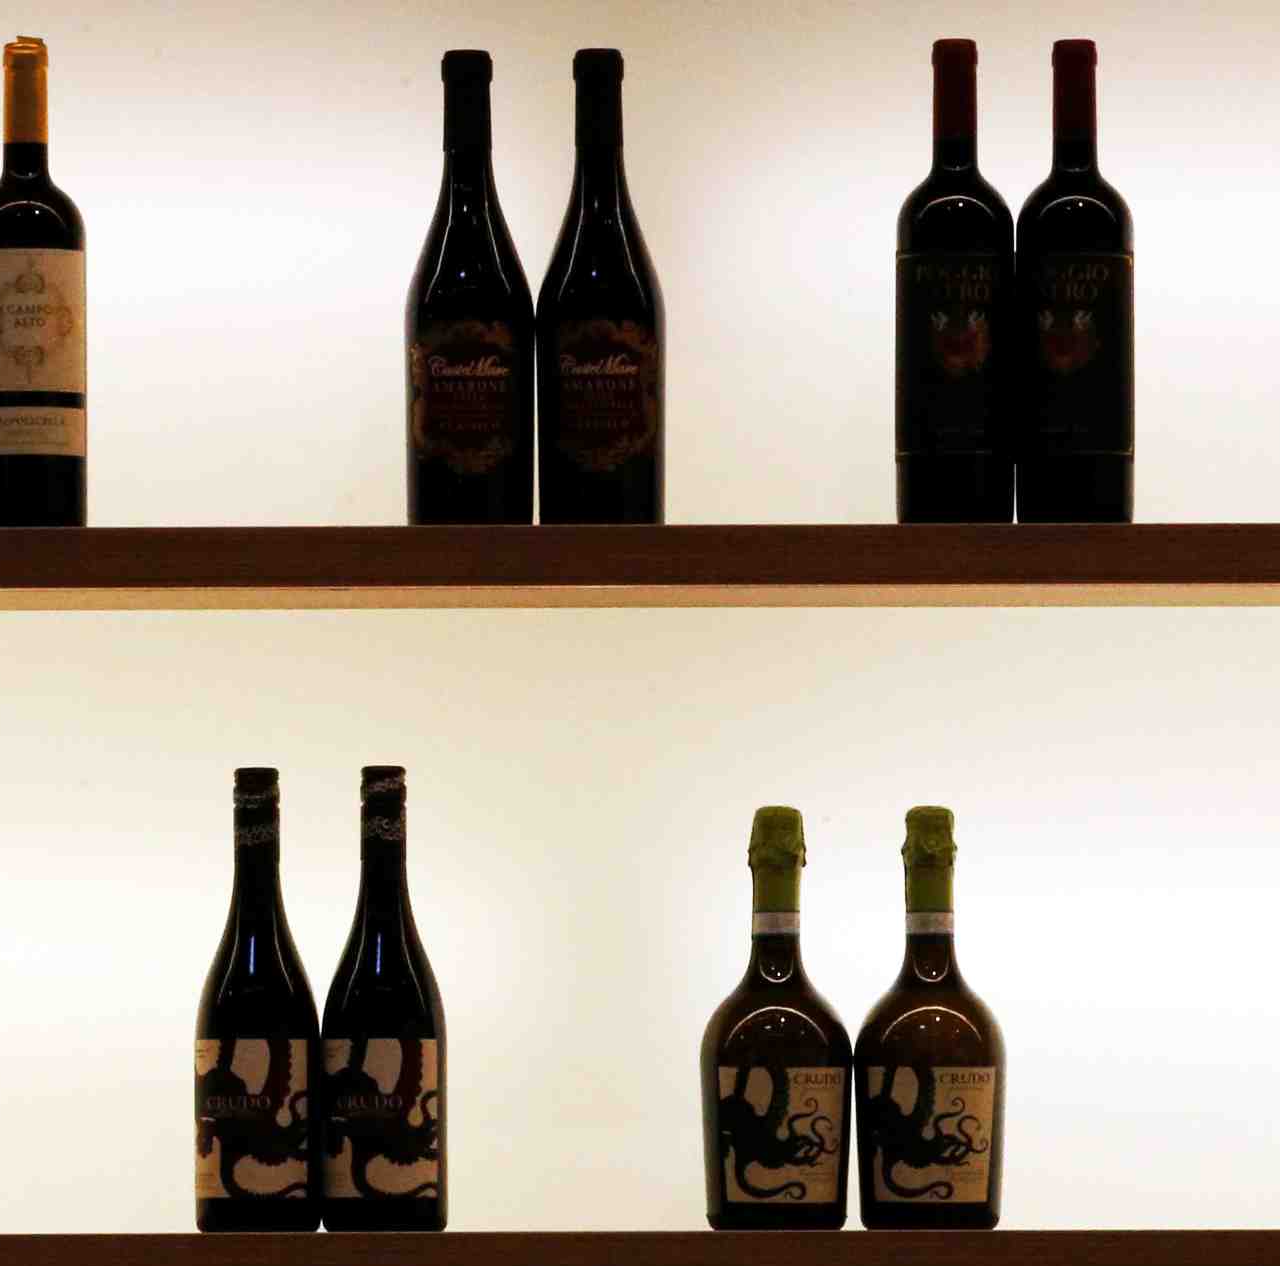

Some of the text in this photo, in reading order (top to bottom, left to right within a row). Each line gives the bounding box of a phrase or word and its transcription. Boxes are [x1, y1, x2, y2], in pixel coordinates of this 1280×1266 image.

[6, 303, 53, 316] CAMPO
[14, 317, 46, 329] ALTO
[794, 1072, 841, 1085] CRUDO
[940, 1072, 990, 1085] CRUDO
